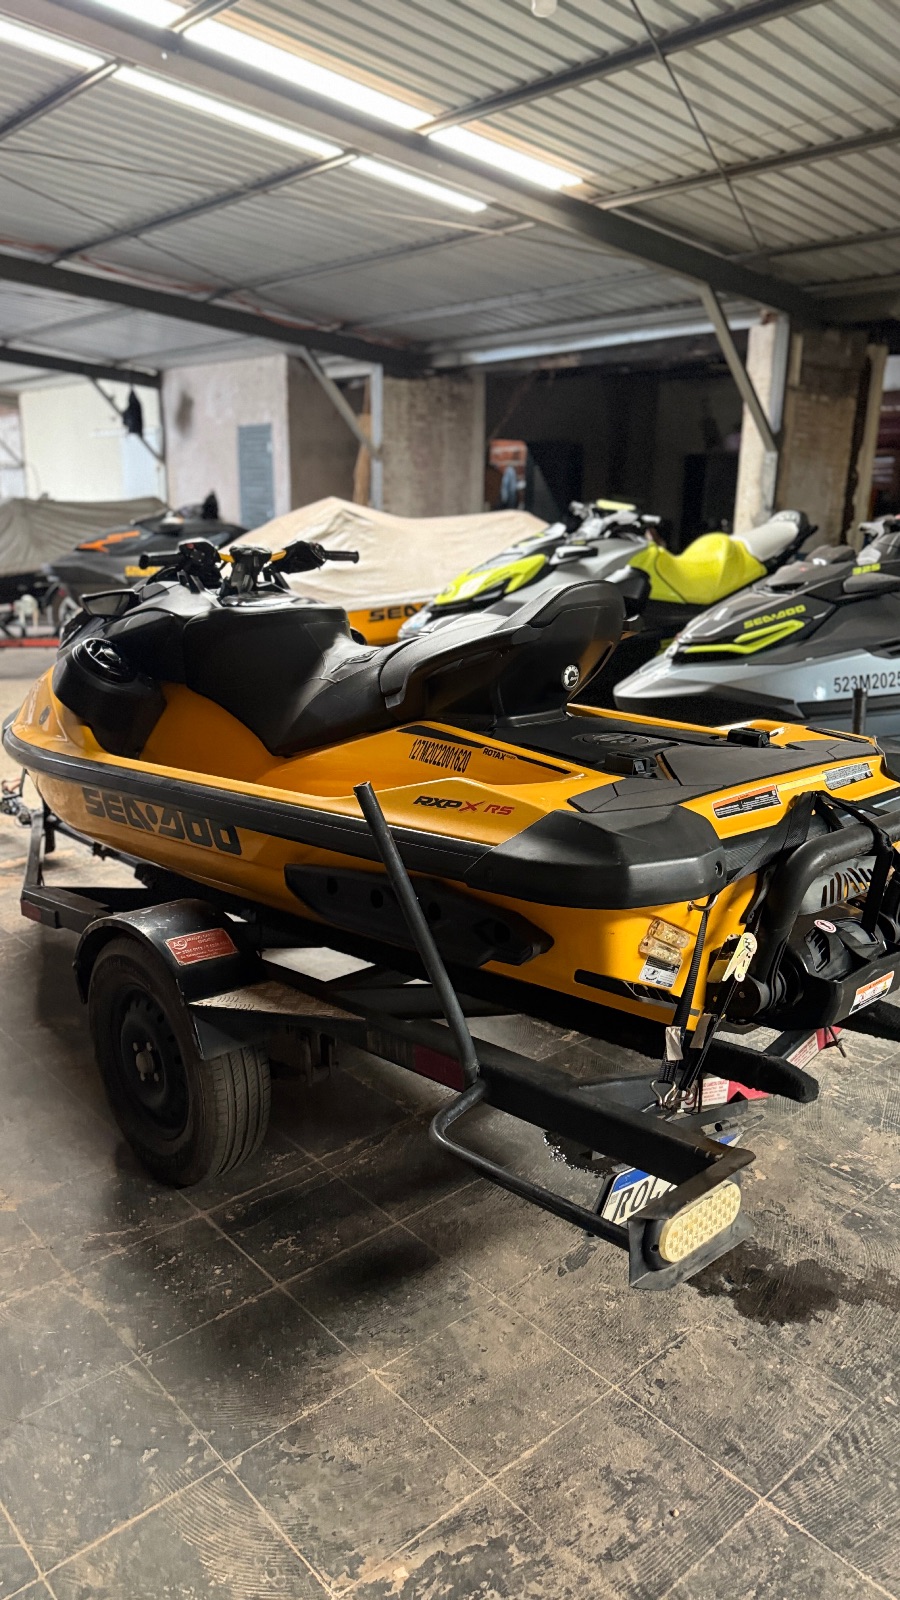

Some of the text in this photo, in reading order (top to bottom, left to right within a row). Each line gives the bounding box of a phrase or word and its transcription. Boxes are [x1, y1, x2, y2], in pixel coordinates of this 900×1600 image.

[408, 738, 472, 773] 127M2022001620
[482, 748, 507, 760] ROTAX
[611, 1177, 671, 1222] ROL
